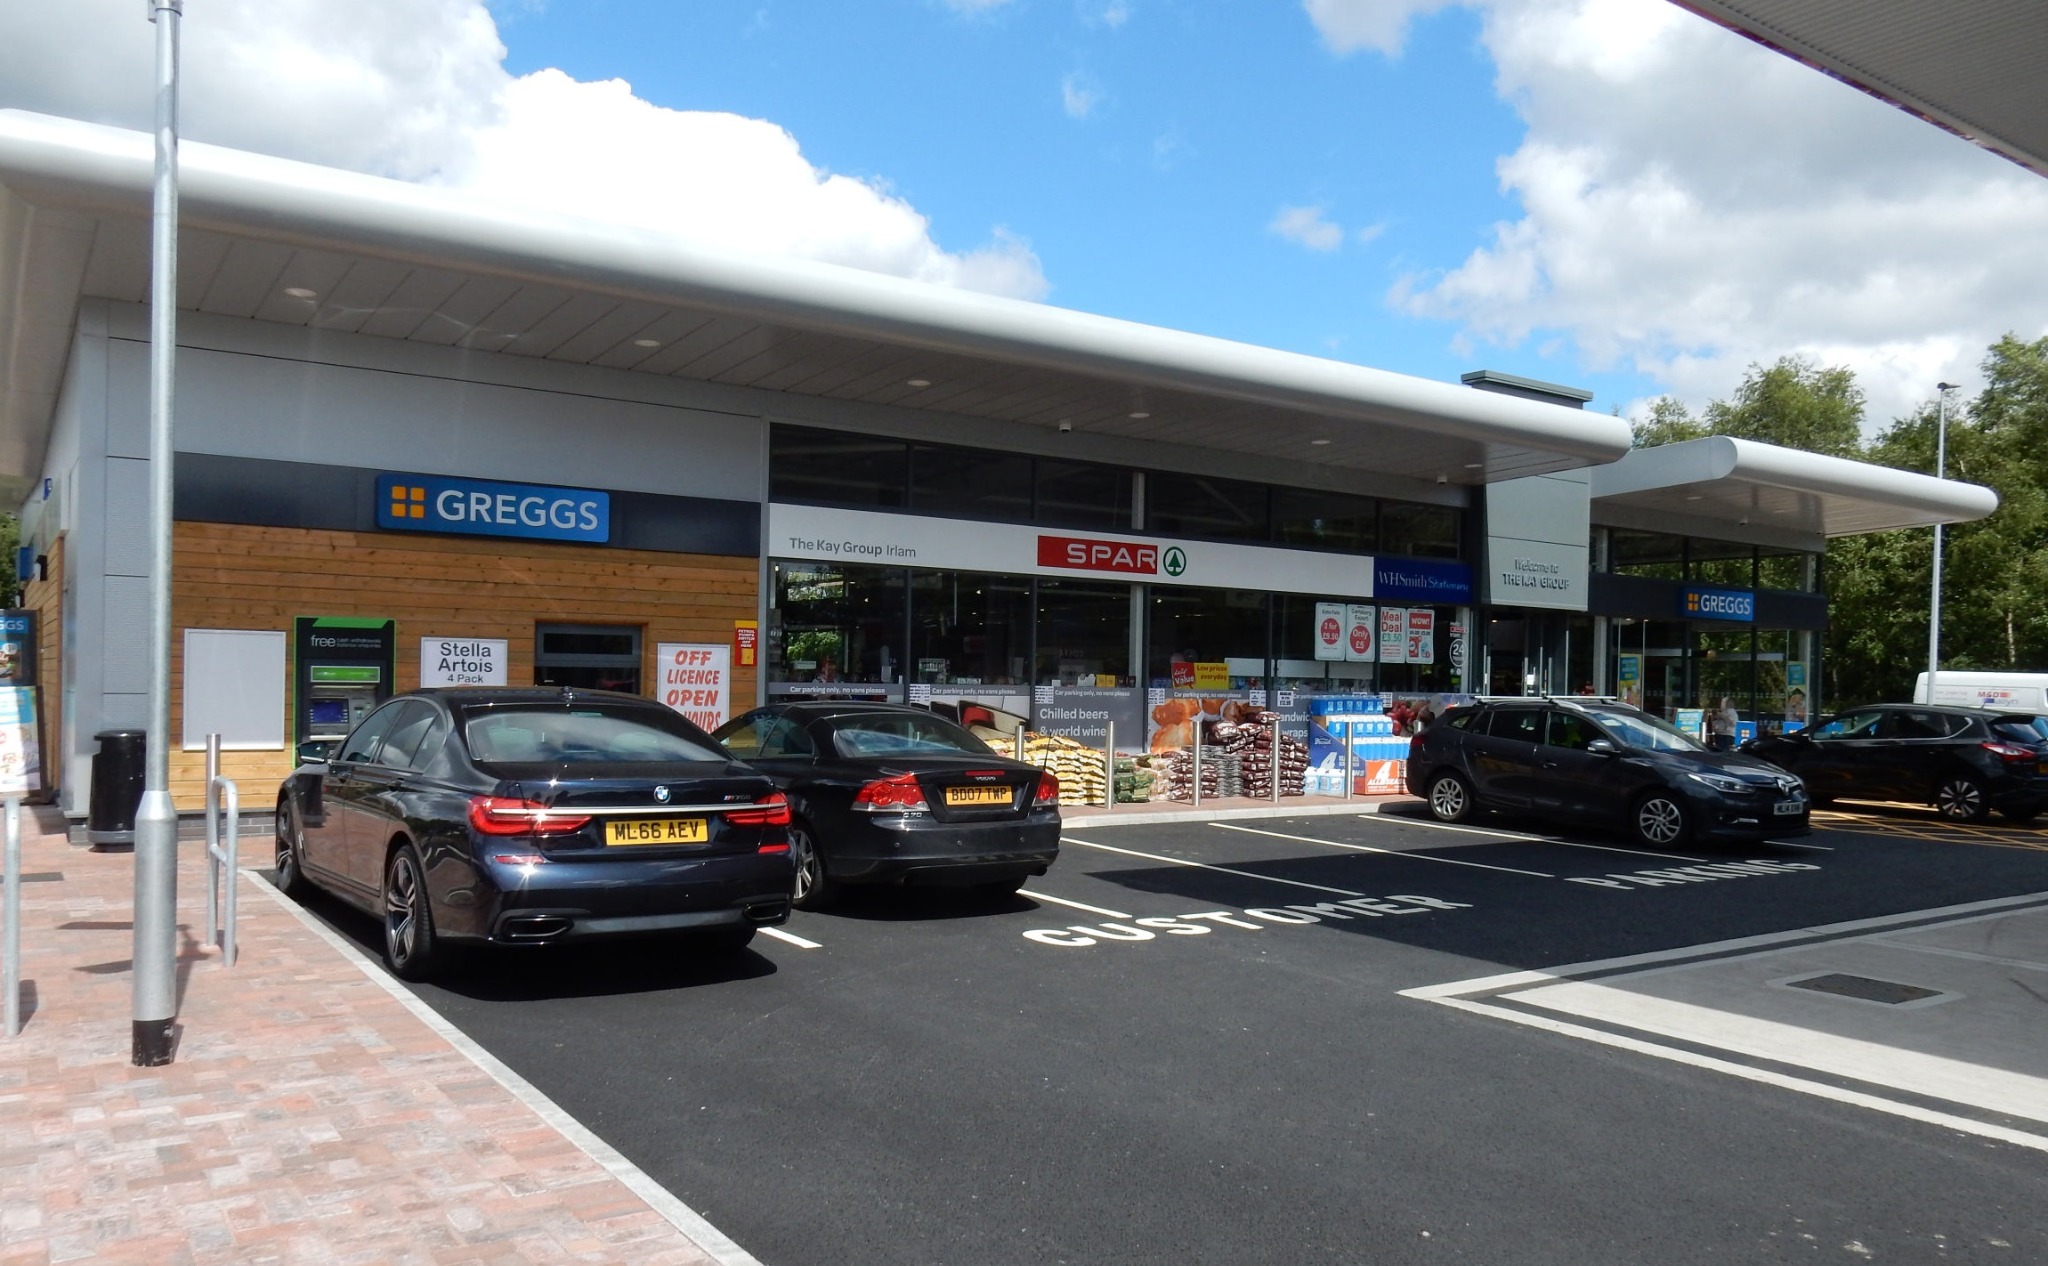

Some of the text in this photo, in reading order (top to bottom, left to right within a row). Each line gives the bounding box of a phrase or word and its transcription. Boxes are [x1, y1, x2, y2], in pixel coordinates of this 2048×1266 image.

[437, 489, 598, 531] GREGGS
[789, 537, 916, 558] The Kay Group Irlam
[1067, 543, 1156, 569] SPAR
[1379, 571, 1427, 588] WHSmith
[1502, 573, 1520, 586] THE
[1700, 594, 1751, 615] GREGGS
[1381, 611, 1402, 622] Meal
[1411, 617, 1430, 625] WOW!
[1328, 622, 1337, 630] for
[1381, 622, 1402, 632] Deal
[311, 634, 336, 647] free
[1352, 629, 1369, 640] Only
[440, 642, 491, 657] Stella
[438, 657, 493, 673] Artois
[674, 650, 712, 666] OFF
[447, 674, 484, 683] 4 Pack
[667, 669, 720, 685] LICENCE
[802, 686, 825, 694] parking
[942, 688, 963, 696] parking
[998, 688, 1016, 696] please
[666, 689, 719, 707] OPEN
[1040, 708, 1109, 719] Chilled beers
[1039, 726, 1048, 736] &
[1050, 725, 1080, 736] world
[1282, 729, 1308, 740] wraps
[951, 787, 1008, 801] BD07 TWP
[615, 821, 699, 841] ML66 AEV
[1564, 859, 1821, 890] PARKING
[1022, 894, 1474, 947] CUSTOMER
